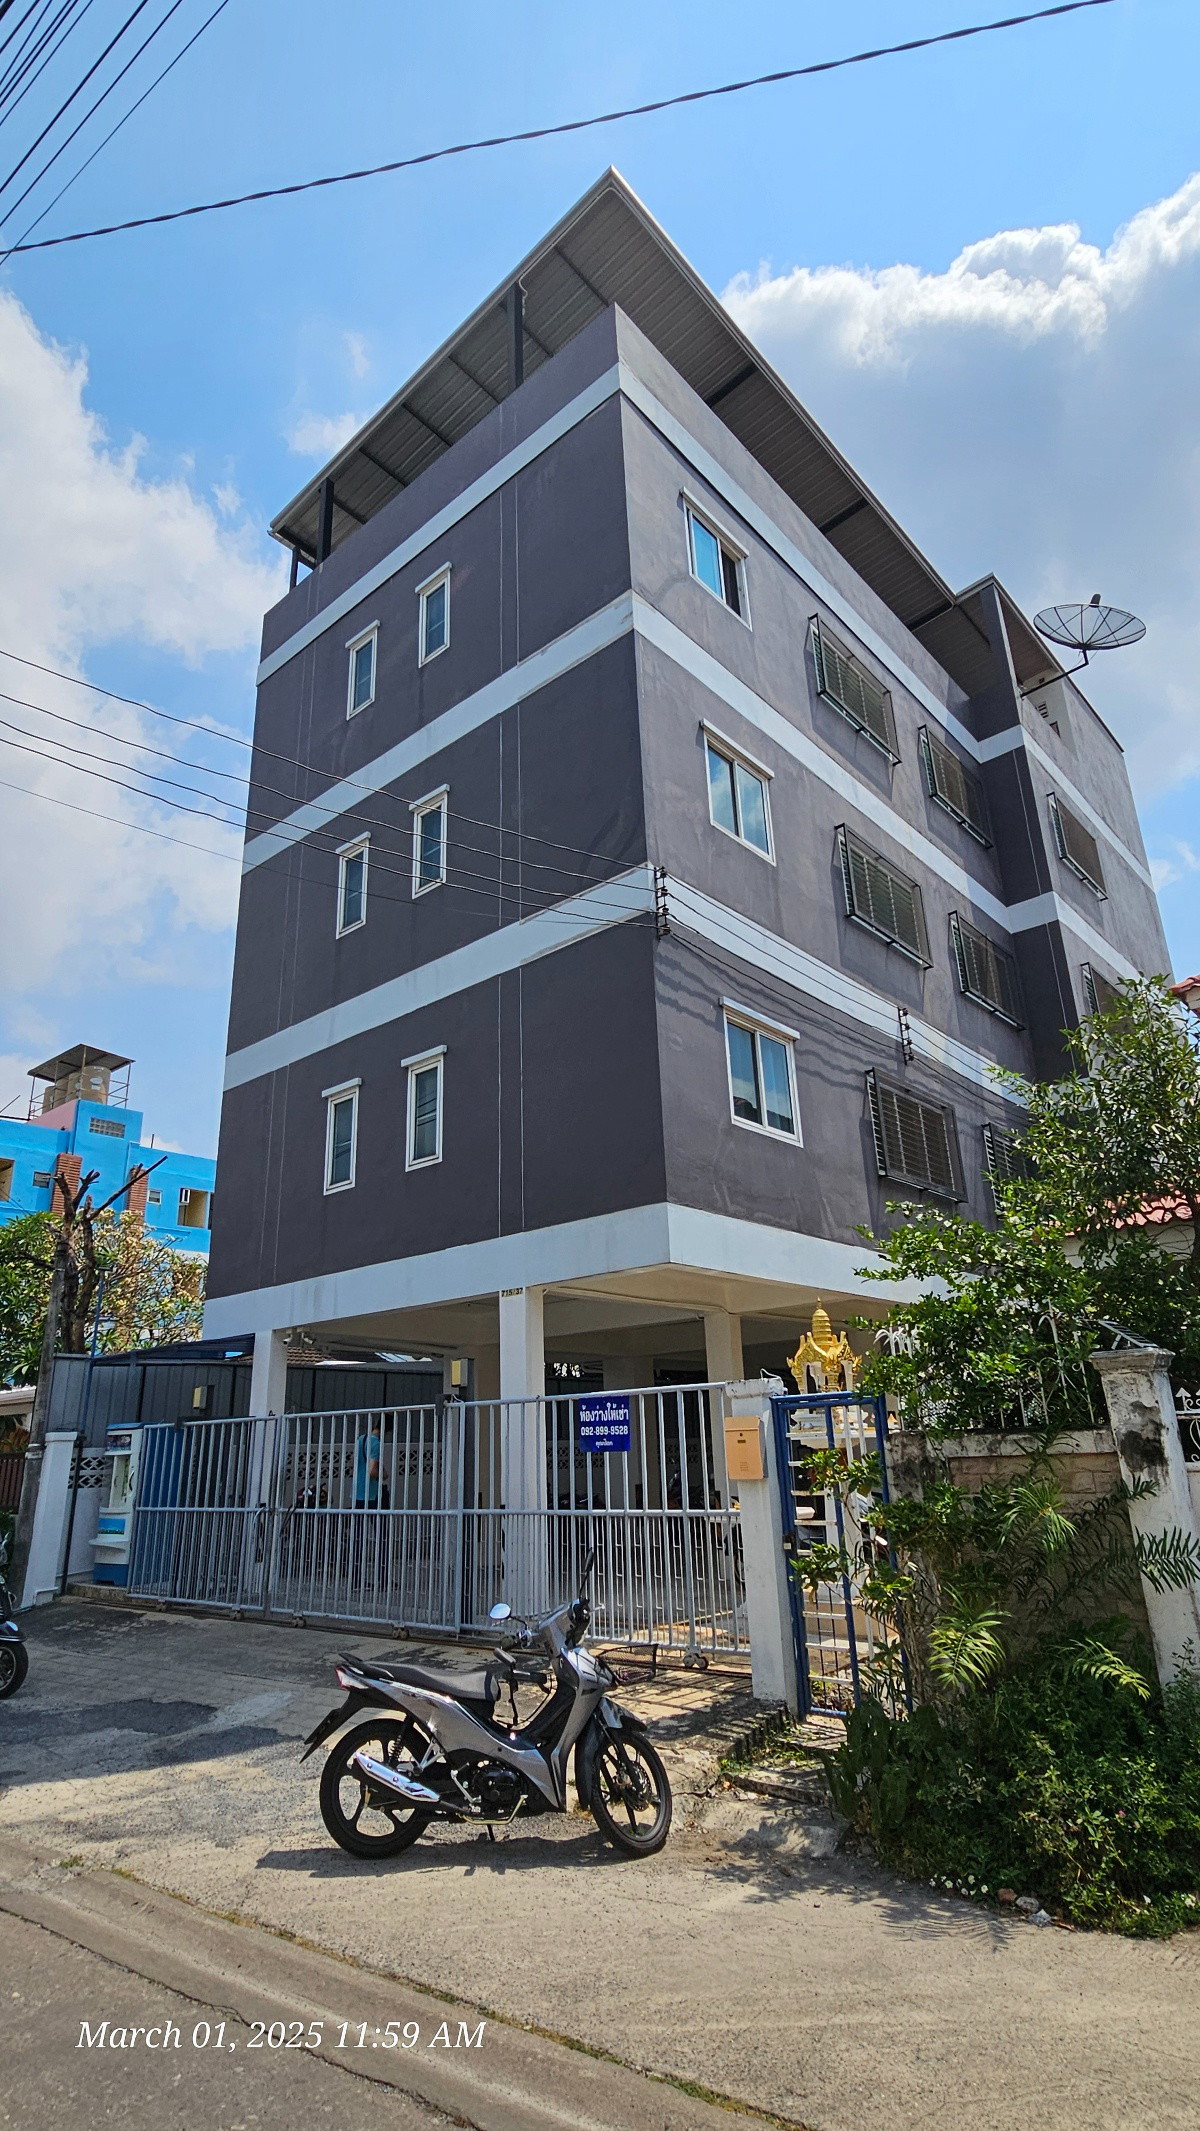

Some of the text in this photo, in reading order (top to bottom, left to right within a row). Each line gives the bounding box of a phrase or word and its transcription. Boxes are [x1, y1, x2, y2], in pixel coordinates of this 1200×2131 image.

[579, 1402, 629, 1422] ห้องว่างให้เช่า
[580, 1425, 629, 1436] 092-899-9528
